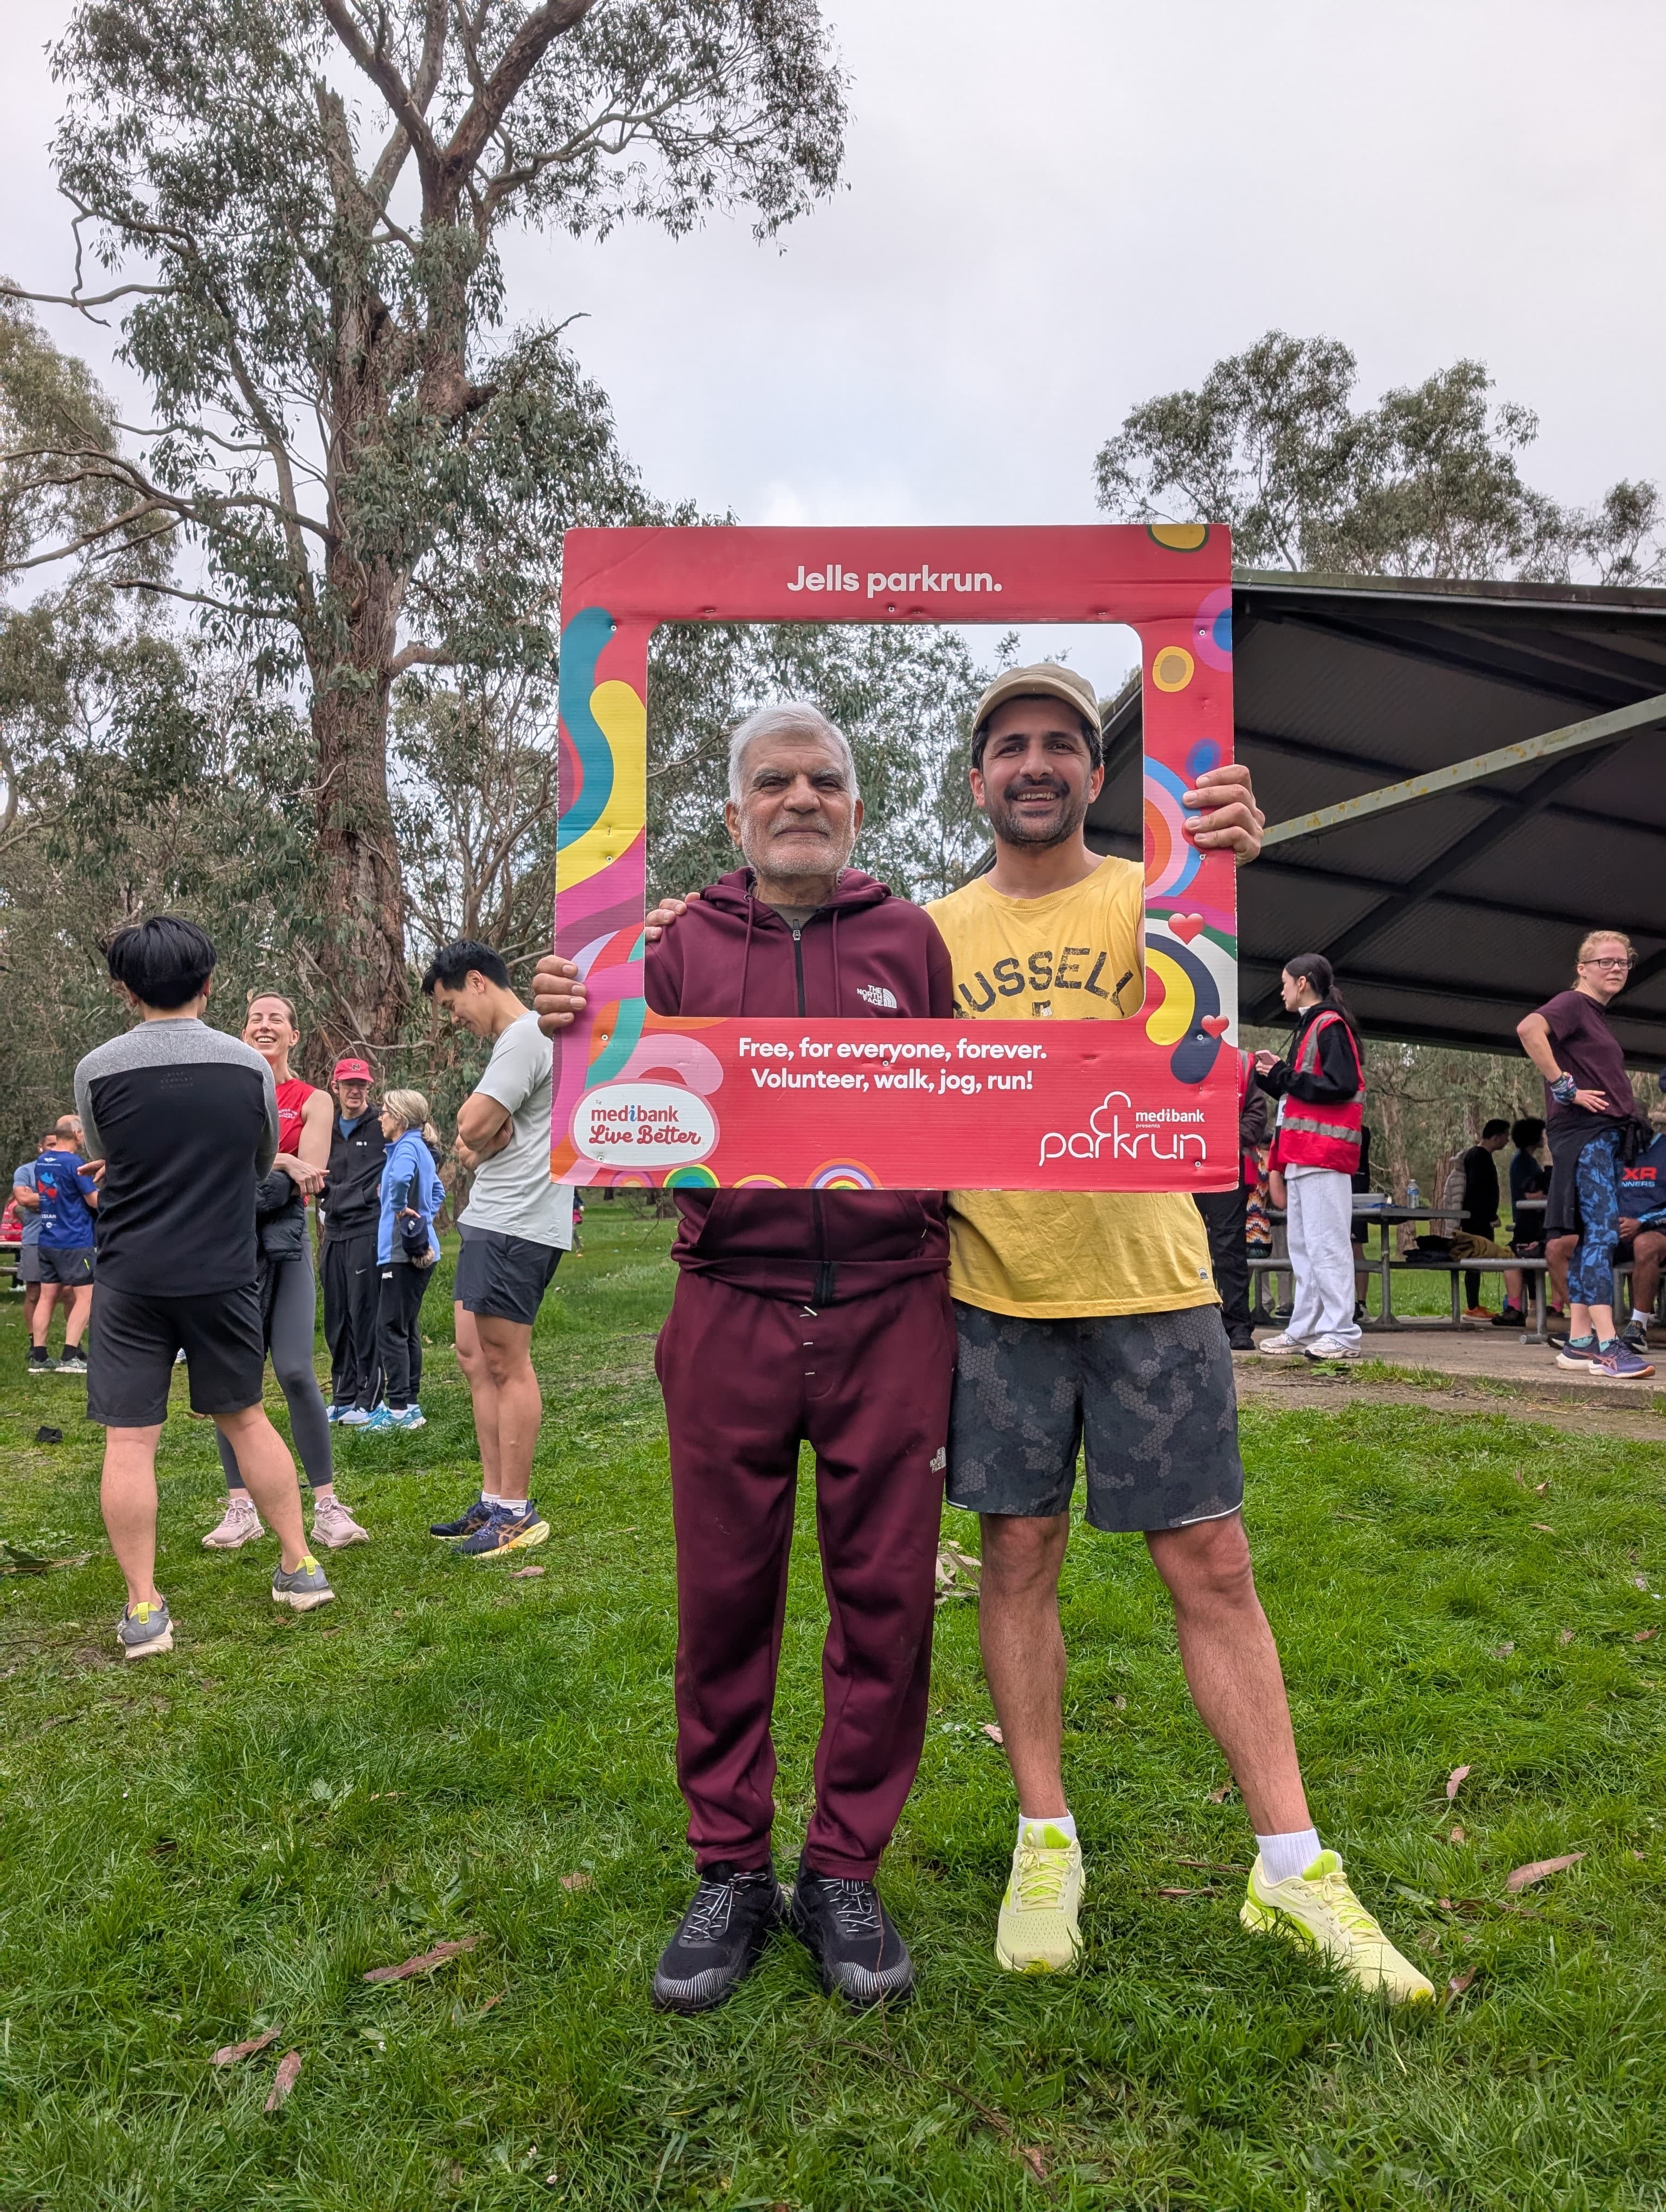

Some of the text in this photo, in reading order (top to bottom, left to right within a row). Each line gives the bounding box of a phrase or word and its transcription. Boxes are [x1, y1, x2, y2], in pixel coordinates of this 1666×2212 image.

[787, 564, 1002, 599] Jells parkrun.
[856, 988, 883, 1000] NORTH
[867, 985, 883, 994] THE
[863, 995, 883, 1006] FACE
[739, 1037, 1047, 1063] Free, for everyone, forever.
[751, 1068, 1033, 1095] Volunteer, walk, jog, run!
[591, 1105, 679, 1122] medibank
[1136, 1108, 1205, 1122] medibank
[588, 1124, 702, 1145] Live Better
[1039, 1091, 1207, 1167] parkrun
